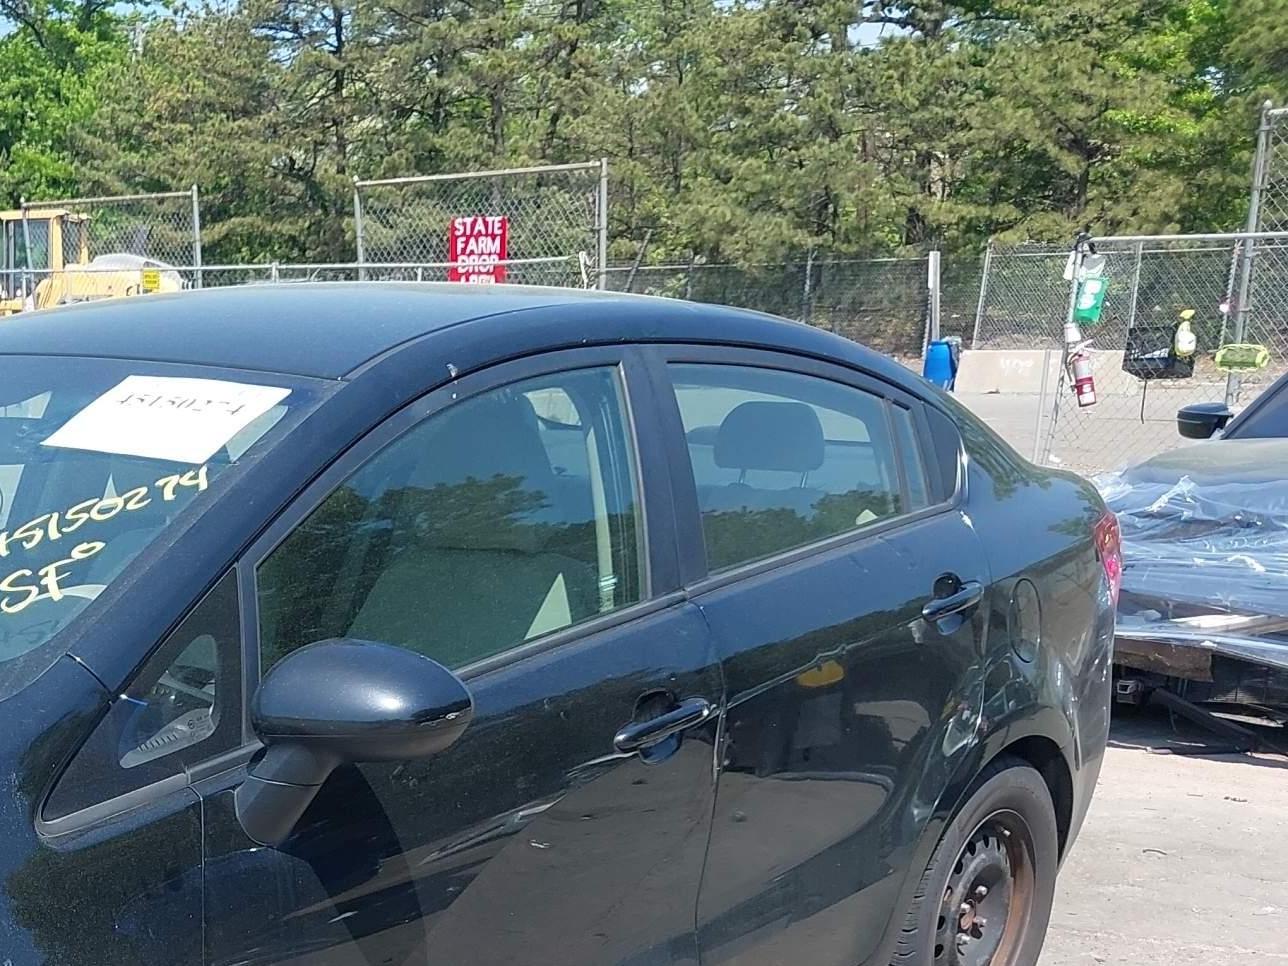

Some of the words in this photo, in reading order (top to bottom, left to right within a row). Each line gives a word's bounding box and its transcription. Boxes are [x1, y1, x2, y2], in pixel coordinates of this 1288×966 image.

[454, 216, 503, 236] STATE
[457, 235, 501, 255] FARM
[457, 254, 499, 274] DROP
